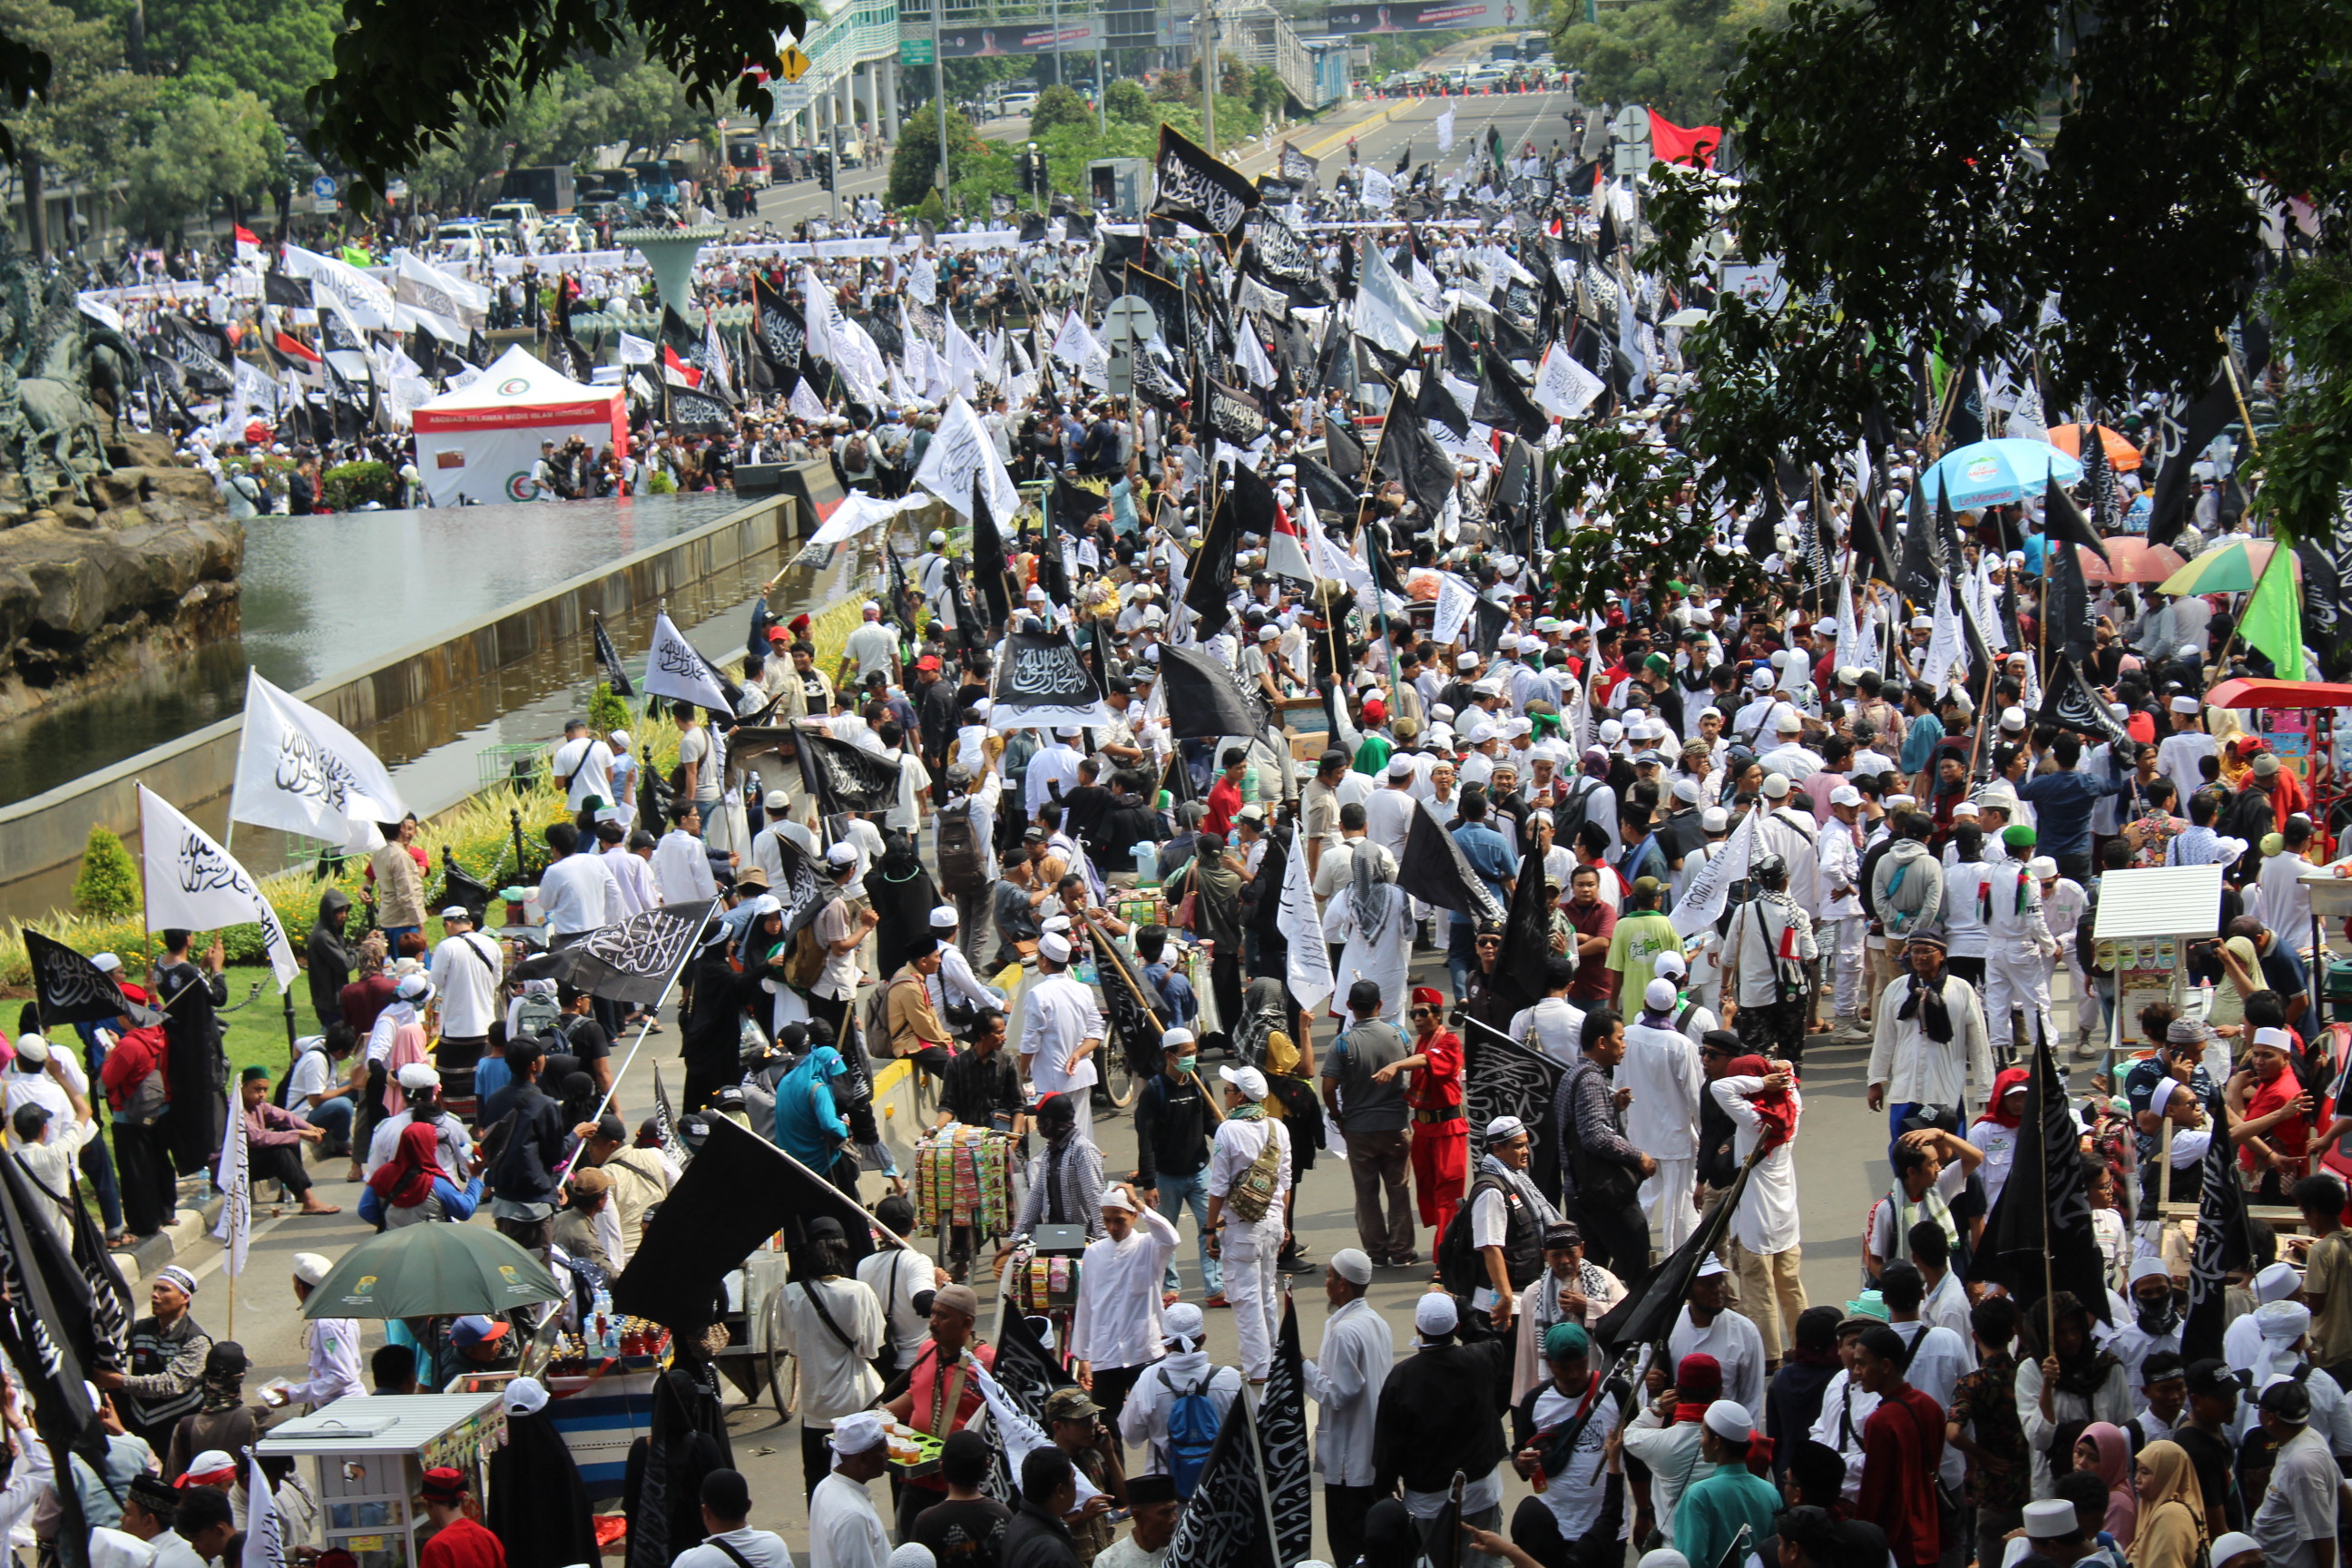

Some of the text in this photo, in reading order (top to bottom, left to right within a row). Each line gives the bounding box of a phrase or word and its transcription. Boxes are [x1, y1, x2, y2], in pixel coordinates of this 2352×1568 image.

[429, 407, 596, 424] ASOSIASI RELAWAN MEDIS ISLAM INDONESIA
[1958, 490, 2013, 507] Le Minerale
